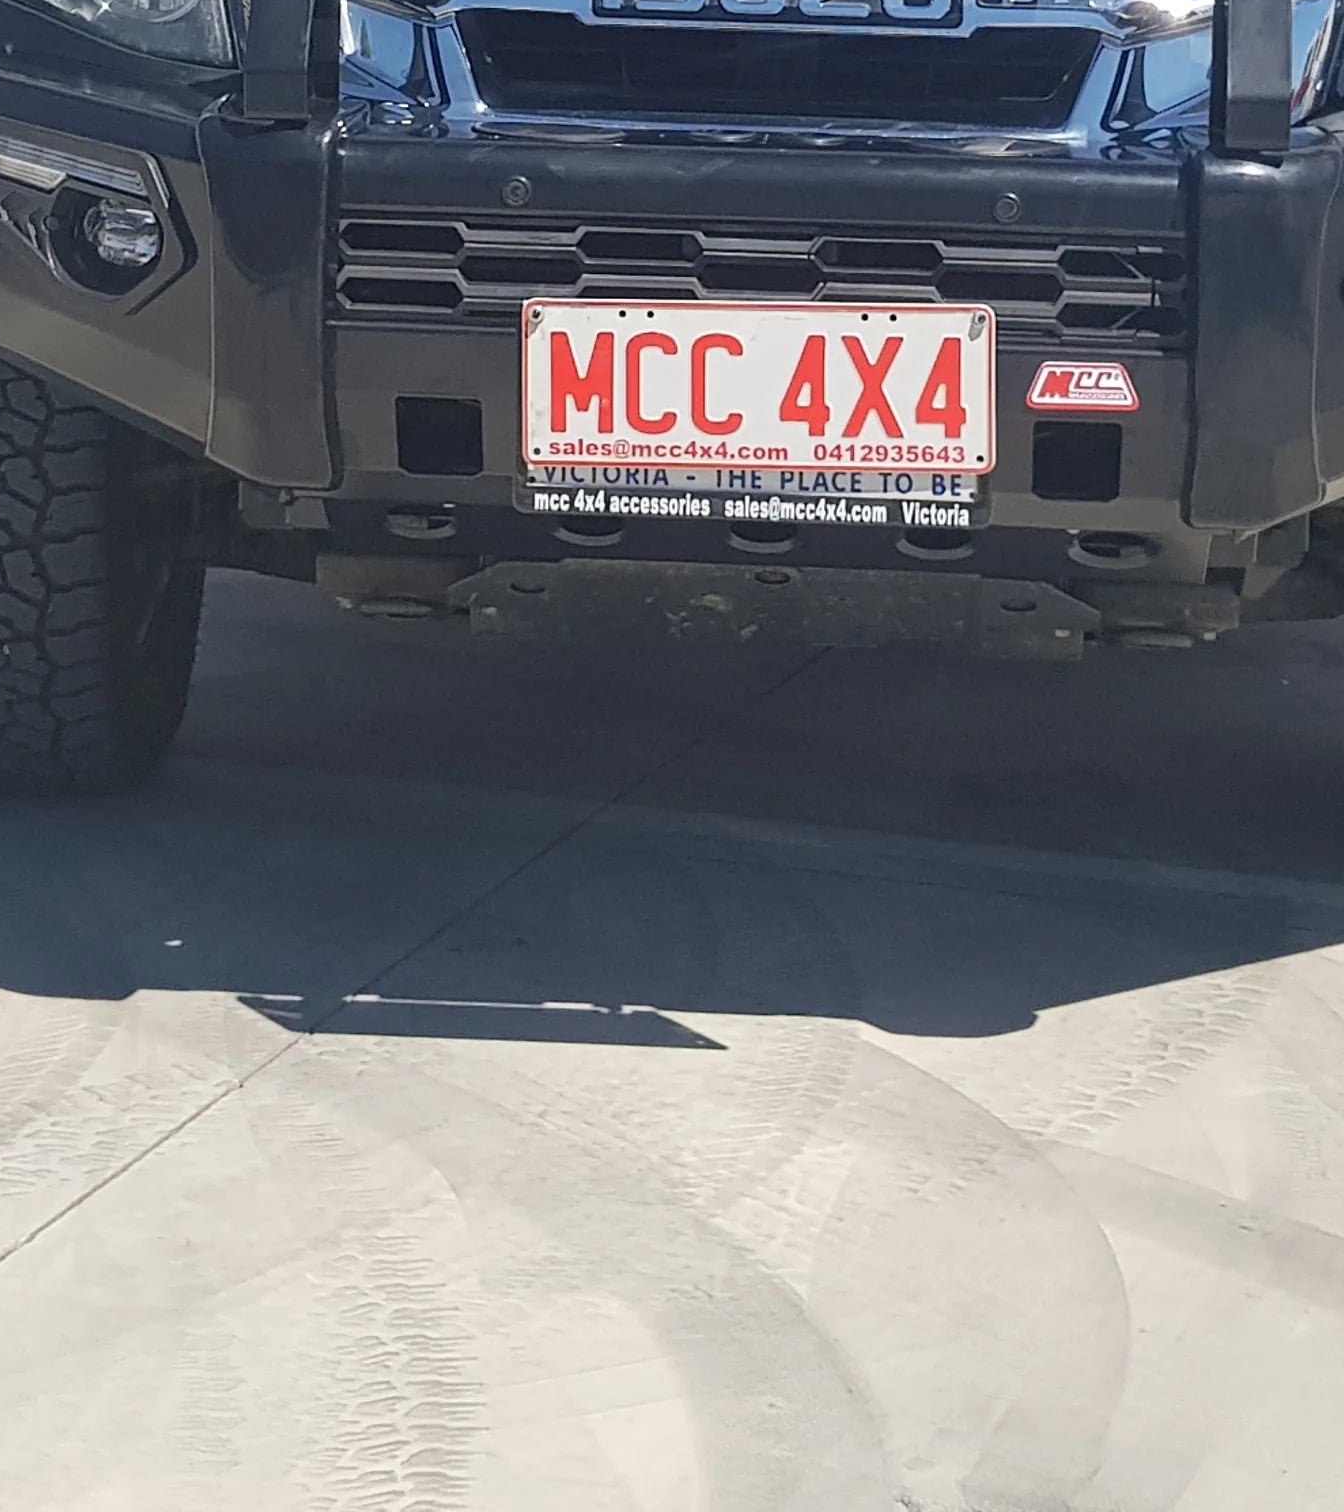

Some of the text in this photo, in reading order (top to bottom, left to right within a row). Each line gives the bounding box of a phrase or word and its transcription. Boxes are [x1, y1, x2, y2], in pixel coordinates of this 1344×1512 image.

[550, 331, 967, 439] MCC 4X4
[1037, 370, 1124, 398] MCC
[548, 439, 966, 463] sales@mcc4x4.com 0412935643
[543, 466, 669, 486] VICTORIA
[715, 469, 763, 490] THE
[779, 470, 863, 493] PLACE
[878, 472, 913, 495] TO
[931, 474, 962, 497] BE
[533, 489, 971, 527] mcc 4x4 accessories sales@mcc4x4.com Victoria
